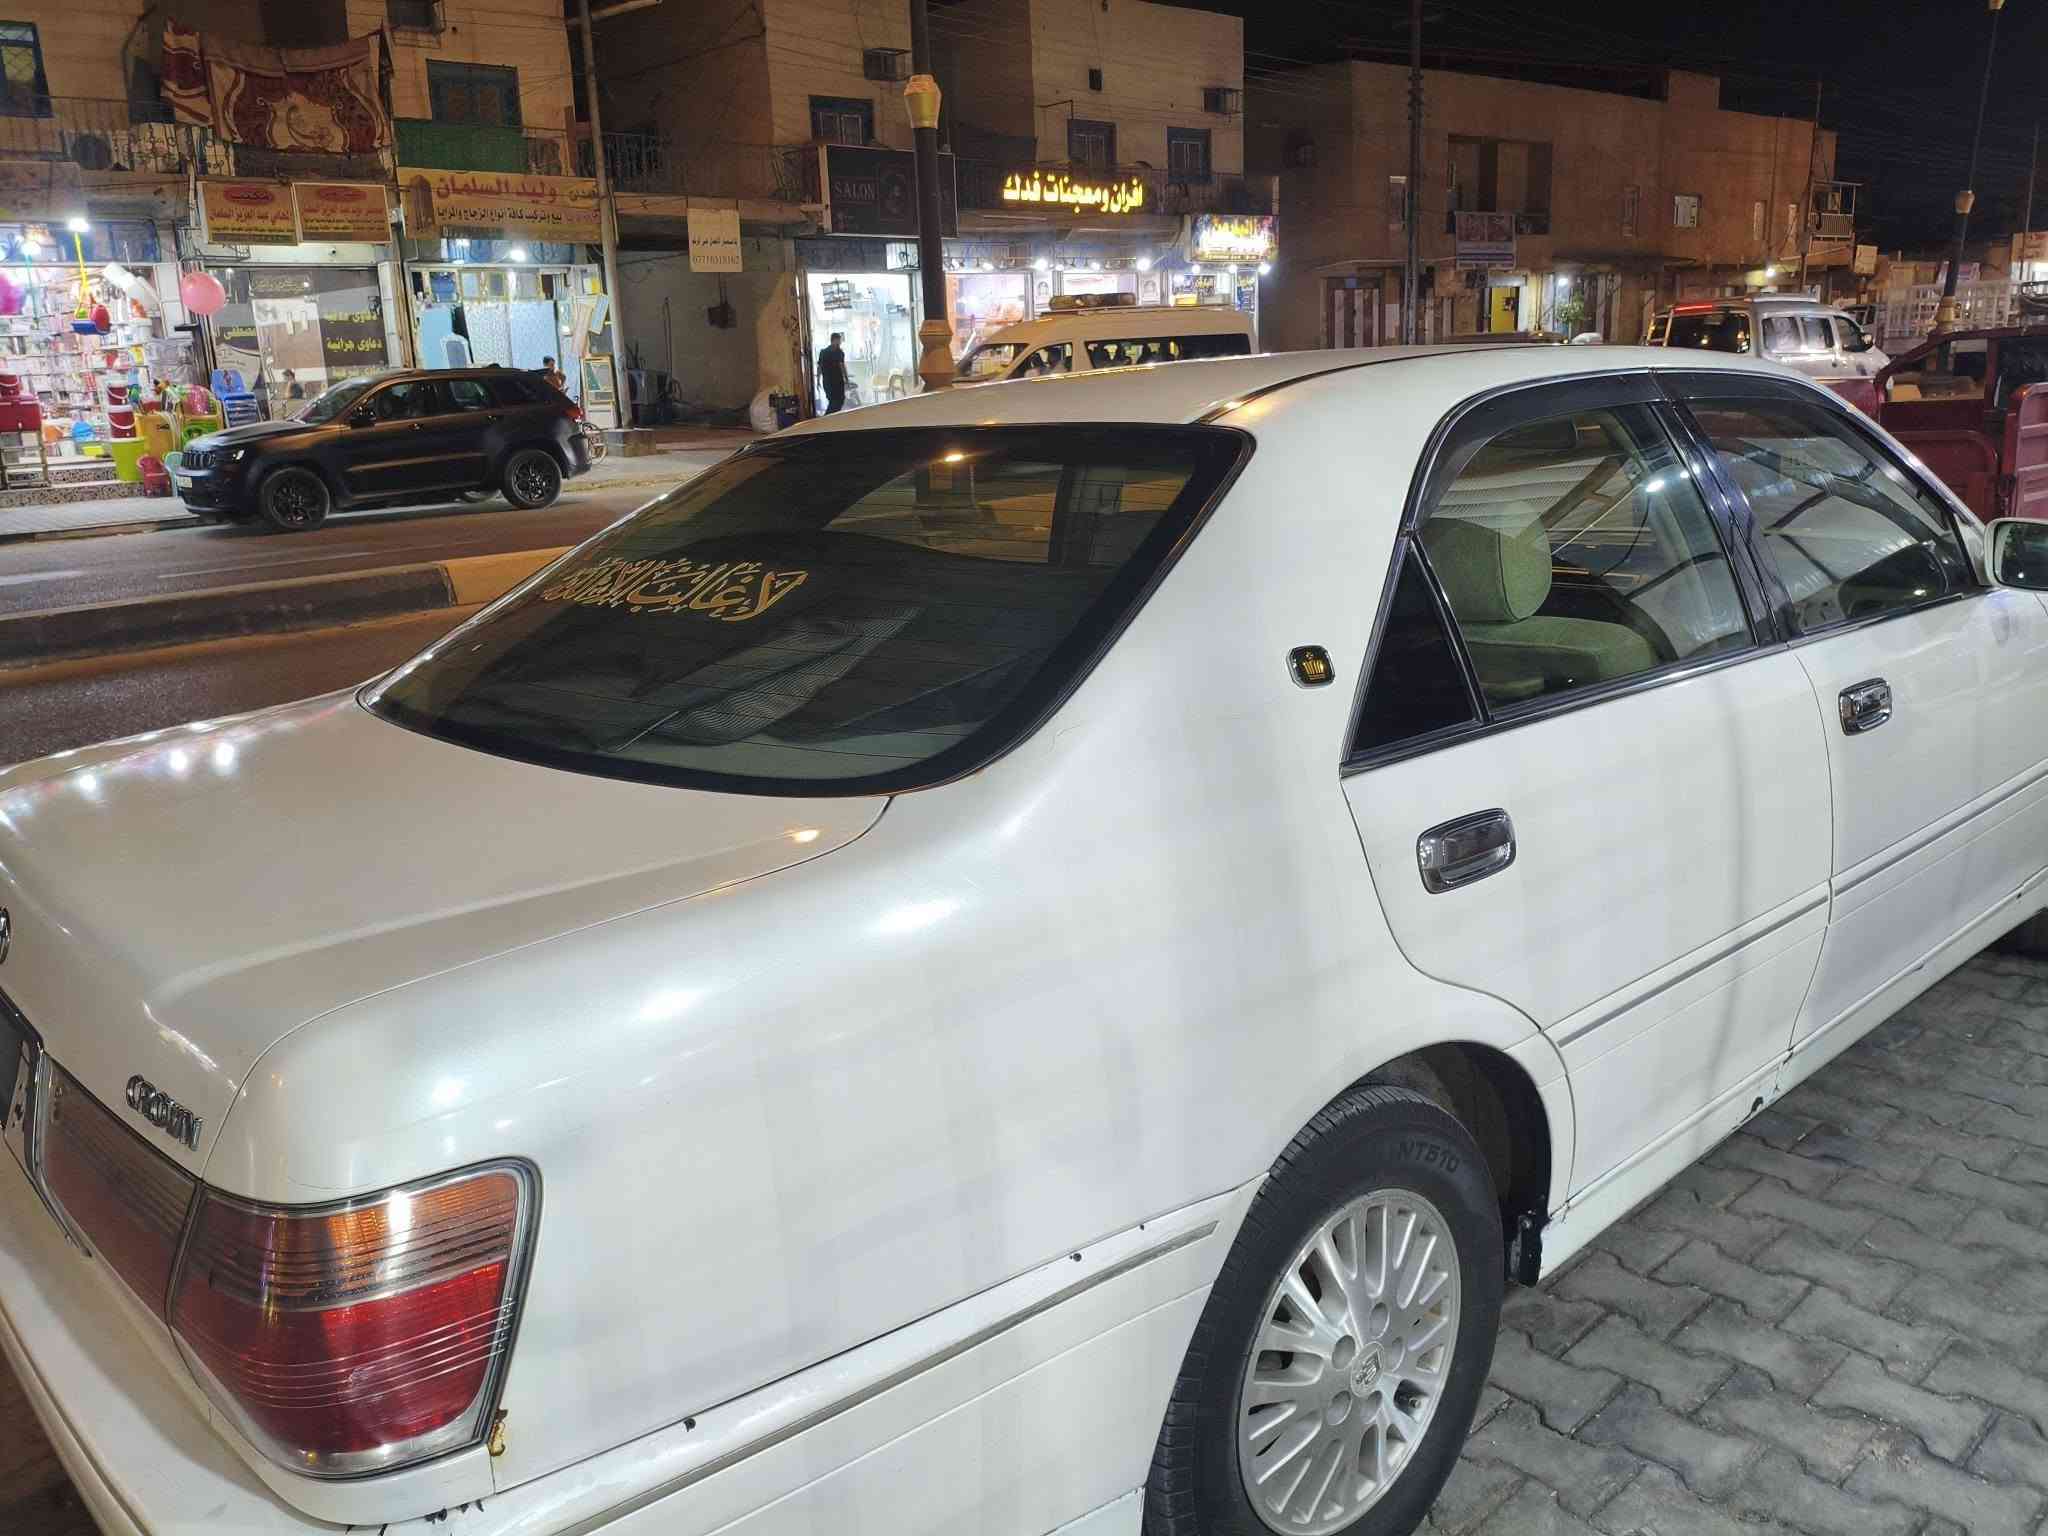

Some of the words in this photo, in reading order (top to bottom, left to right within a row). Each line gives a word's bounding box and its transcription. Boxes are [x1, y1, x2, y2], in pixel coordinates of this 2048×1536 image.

[436, 174, 513, 199] السلمان
[515, 176, 558, 203] وليد
[833, 181, 876, 201] SALON
[1003, 171, 1041, 201] فدك
[1043, 174, 1109, 213] ومعجنات
[125, 1075, 203, 1152] CROWN
